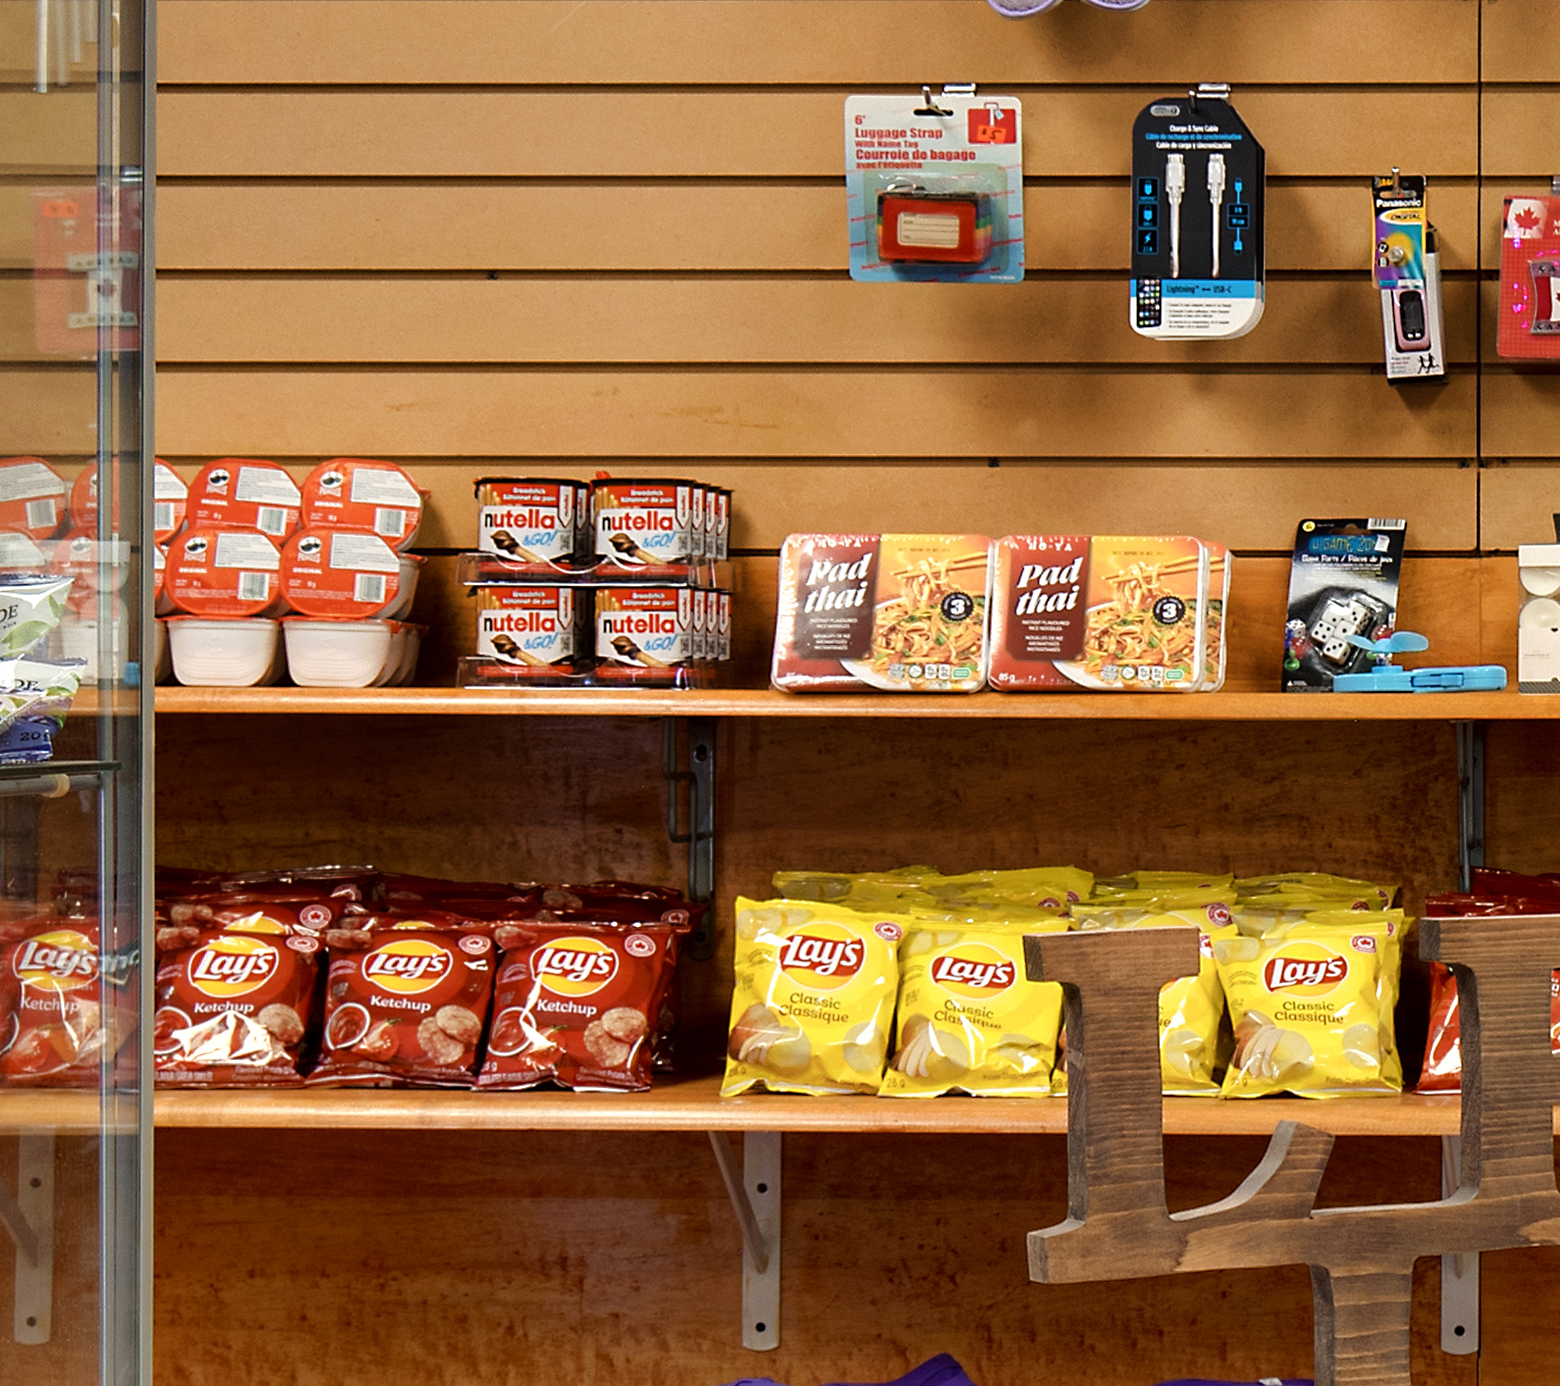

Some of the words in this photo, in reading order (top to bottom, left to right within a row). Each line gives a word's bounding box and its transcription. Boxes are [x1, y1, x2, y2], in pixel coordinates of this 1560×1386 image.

[855, 128, 907, 140] Luggage
[910, 128, 943, 140] Strap
[856, 150, 909, 161] Courroie
[912, 150, 928, 160] de
[930, 150, 977, 162] bagage
[1376, 198, 1422, 208] Panasonic
[485, 511, 556, 529] nutella
[602, 511, 673, 531] nutella
[807, 553, 872, 586] Pad
[1017, 556, 1083, 589] Pad
[804, 581, 868, 614] thai
[950, 598, 966, 616] 3
[1015, 585, 1080, 616] thai
[1162, 602, 1177, 619] 3
[484, 613, 555, 632] nutella
[603, 615, 675, 633] nutella
[18, 940, 96, 977] Lay's
[191, 945, 273, 981] Lay's
[368, 946, 448, 980] Lay's
[535, 945, 615, 981] Lay's
[785, 934, 865, 974] Lay's
[934, 955, 1015, 986] Lay's
[1270, 956, 1348, 988] Lay's
[20, 994, 80, 1013] Ketchup
[194, 1000, 254, 1017] Ketchup
[370, 994, 431, 1014] Ketchup
[536, 997, 597, 1016] Ketchup
[790, 991, 842, 1010] Classic
[944, 999, 994, 1020] Classic
[1282, 1000, 1334, 1013] Classic
[779, 1003, 849, 1023] Classique
[933, 1010, 1002, 1030] Classique
[1274, 1010, 1344, 1025] Classique
